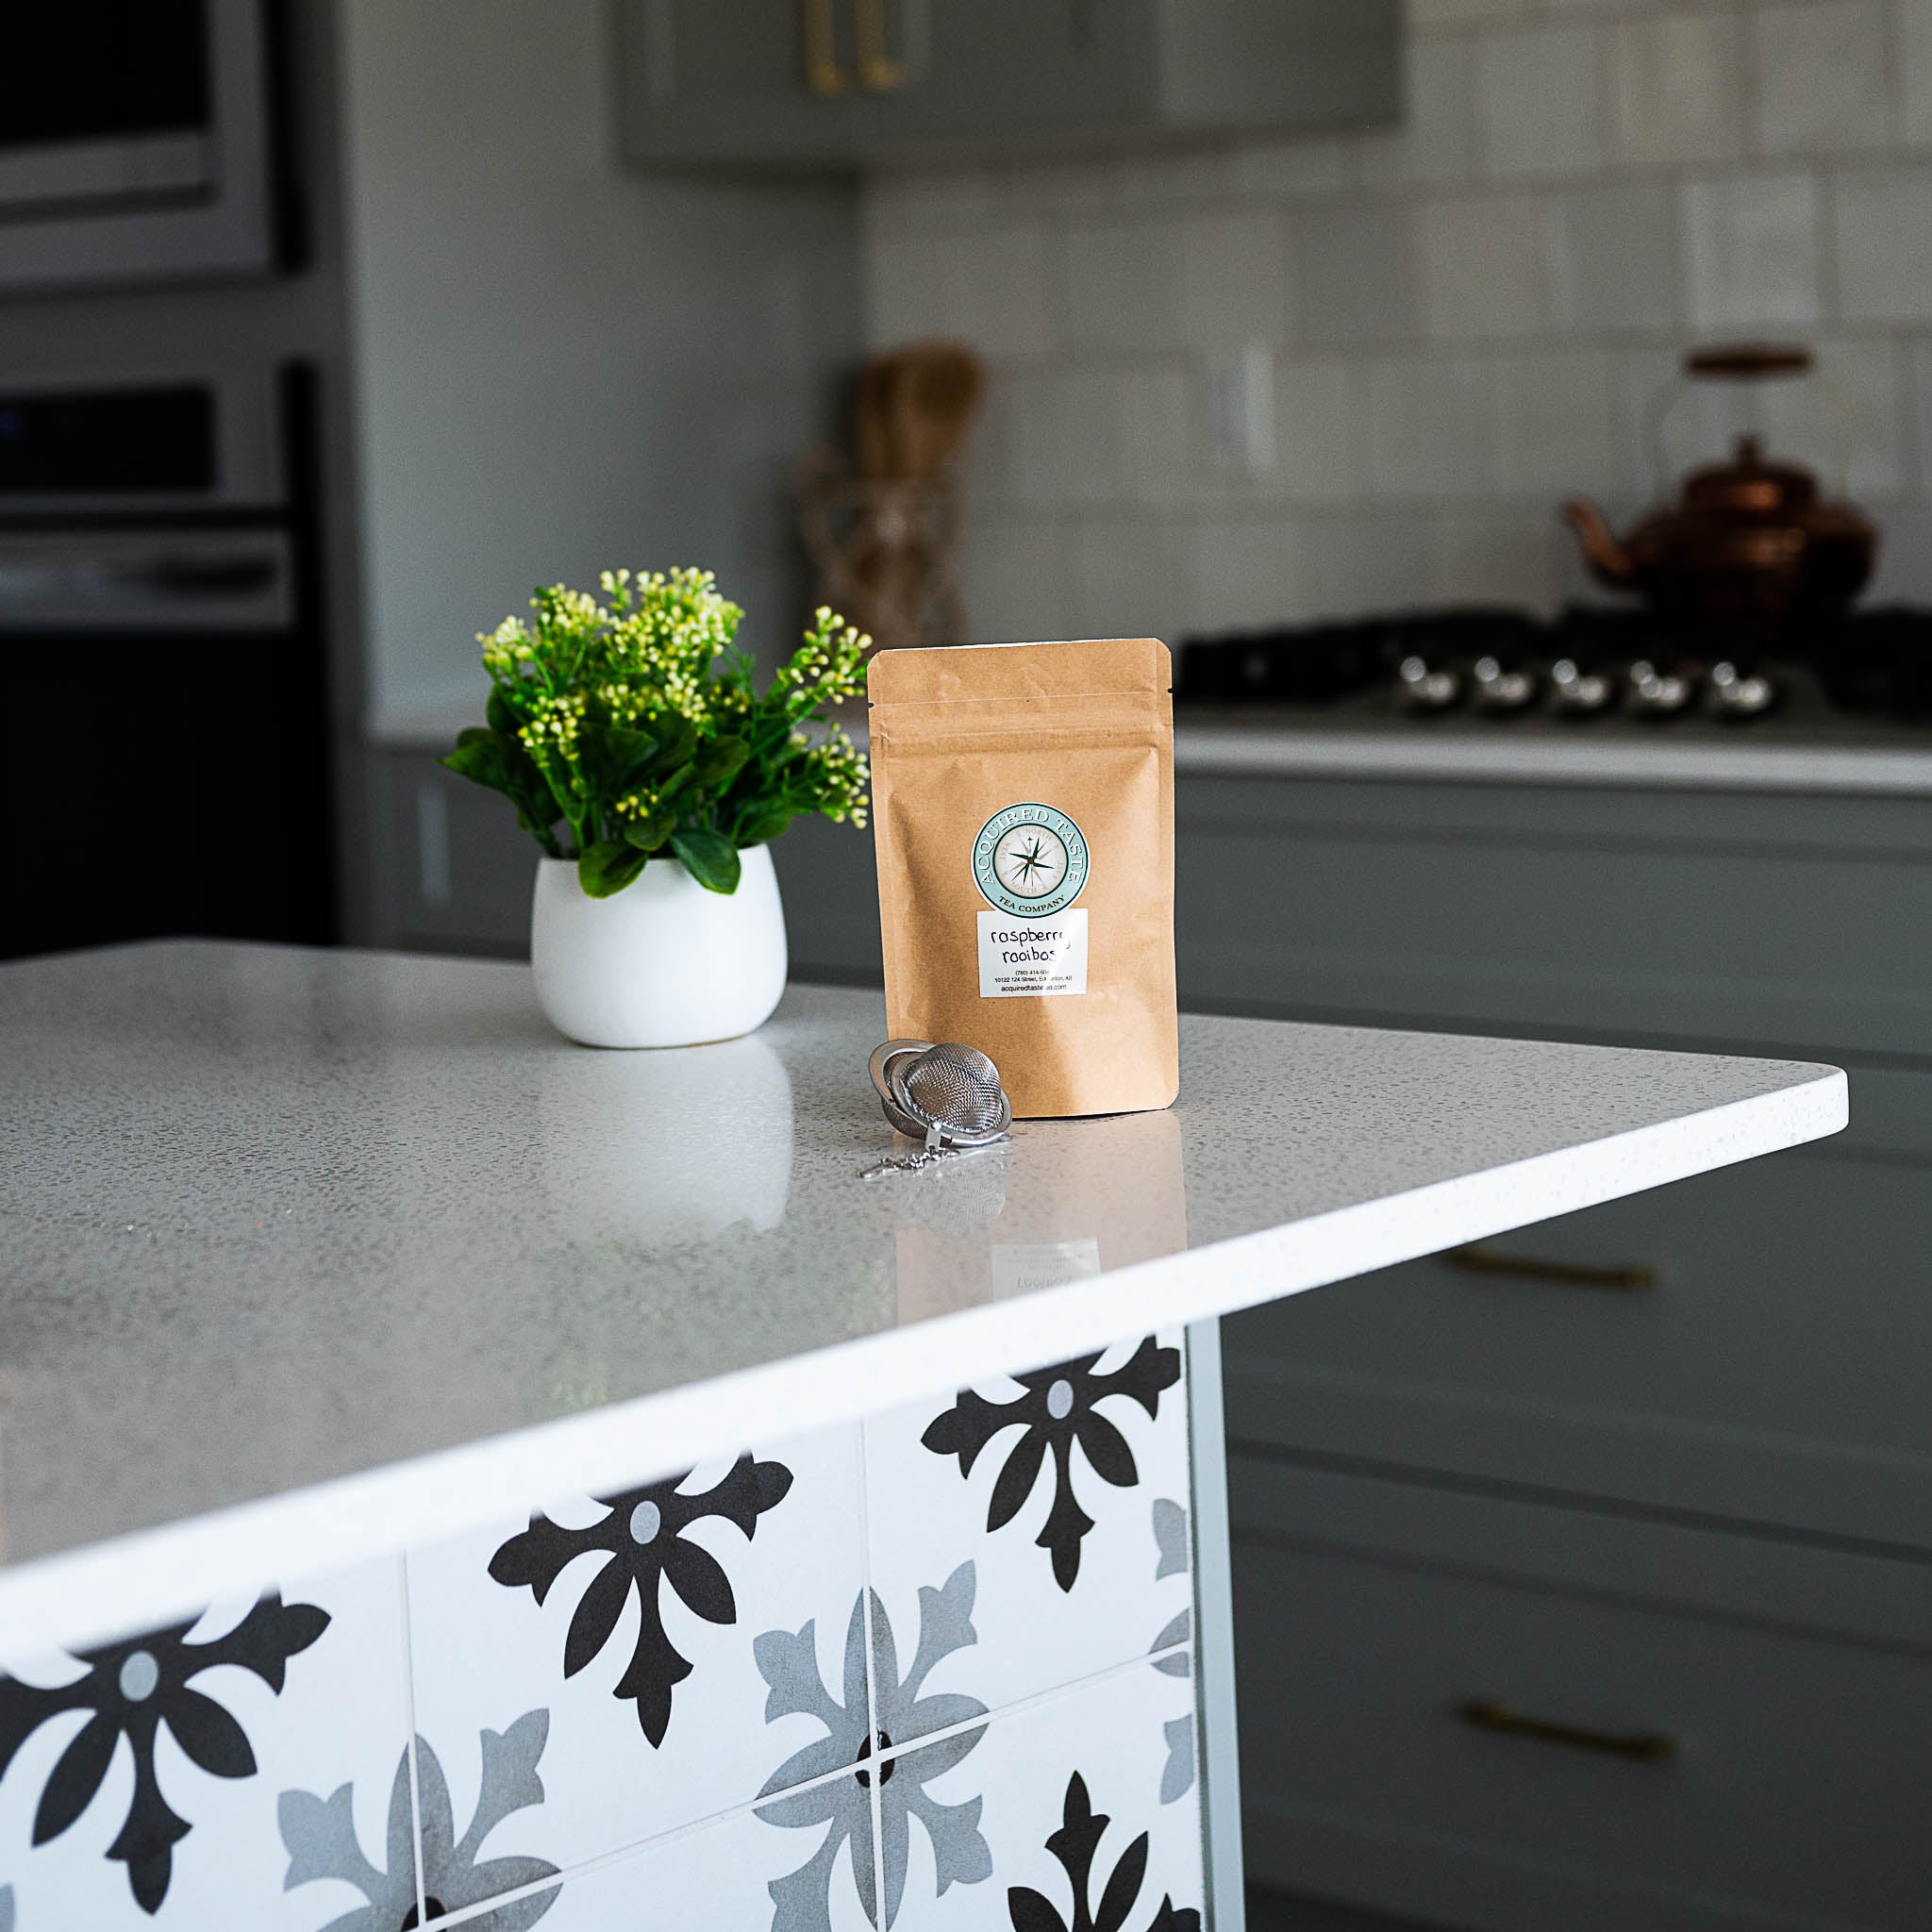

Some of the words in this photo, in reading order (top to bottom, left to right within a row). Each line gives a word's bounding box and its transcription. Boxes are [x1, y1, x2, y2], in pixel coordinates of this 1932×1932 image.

[977, 808, 1050, 885] ACQUIRED
[1056, 818, 1084, 883] TASTE
[999, 895, 1016, 909] TEA
[1018, 894, 1065, 913] COMPANY
[1002, 946, 1057, 963] rooibos
